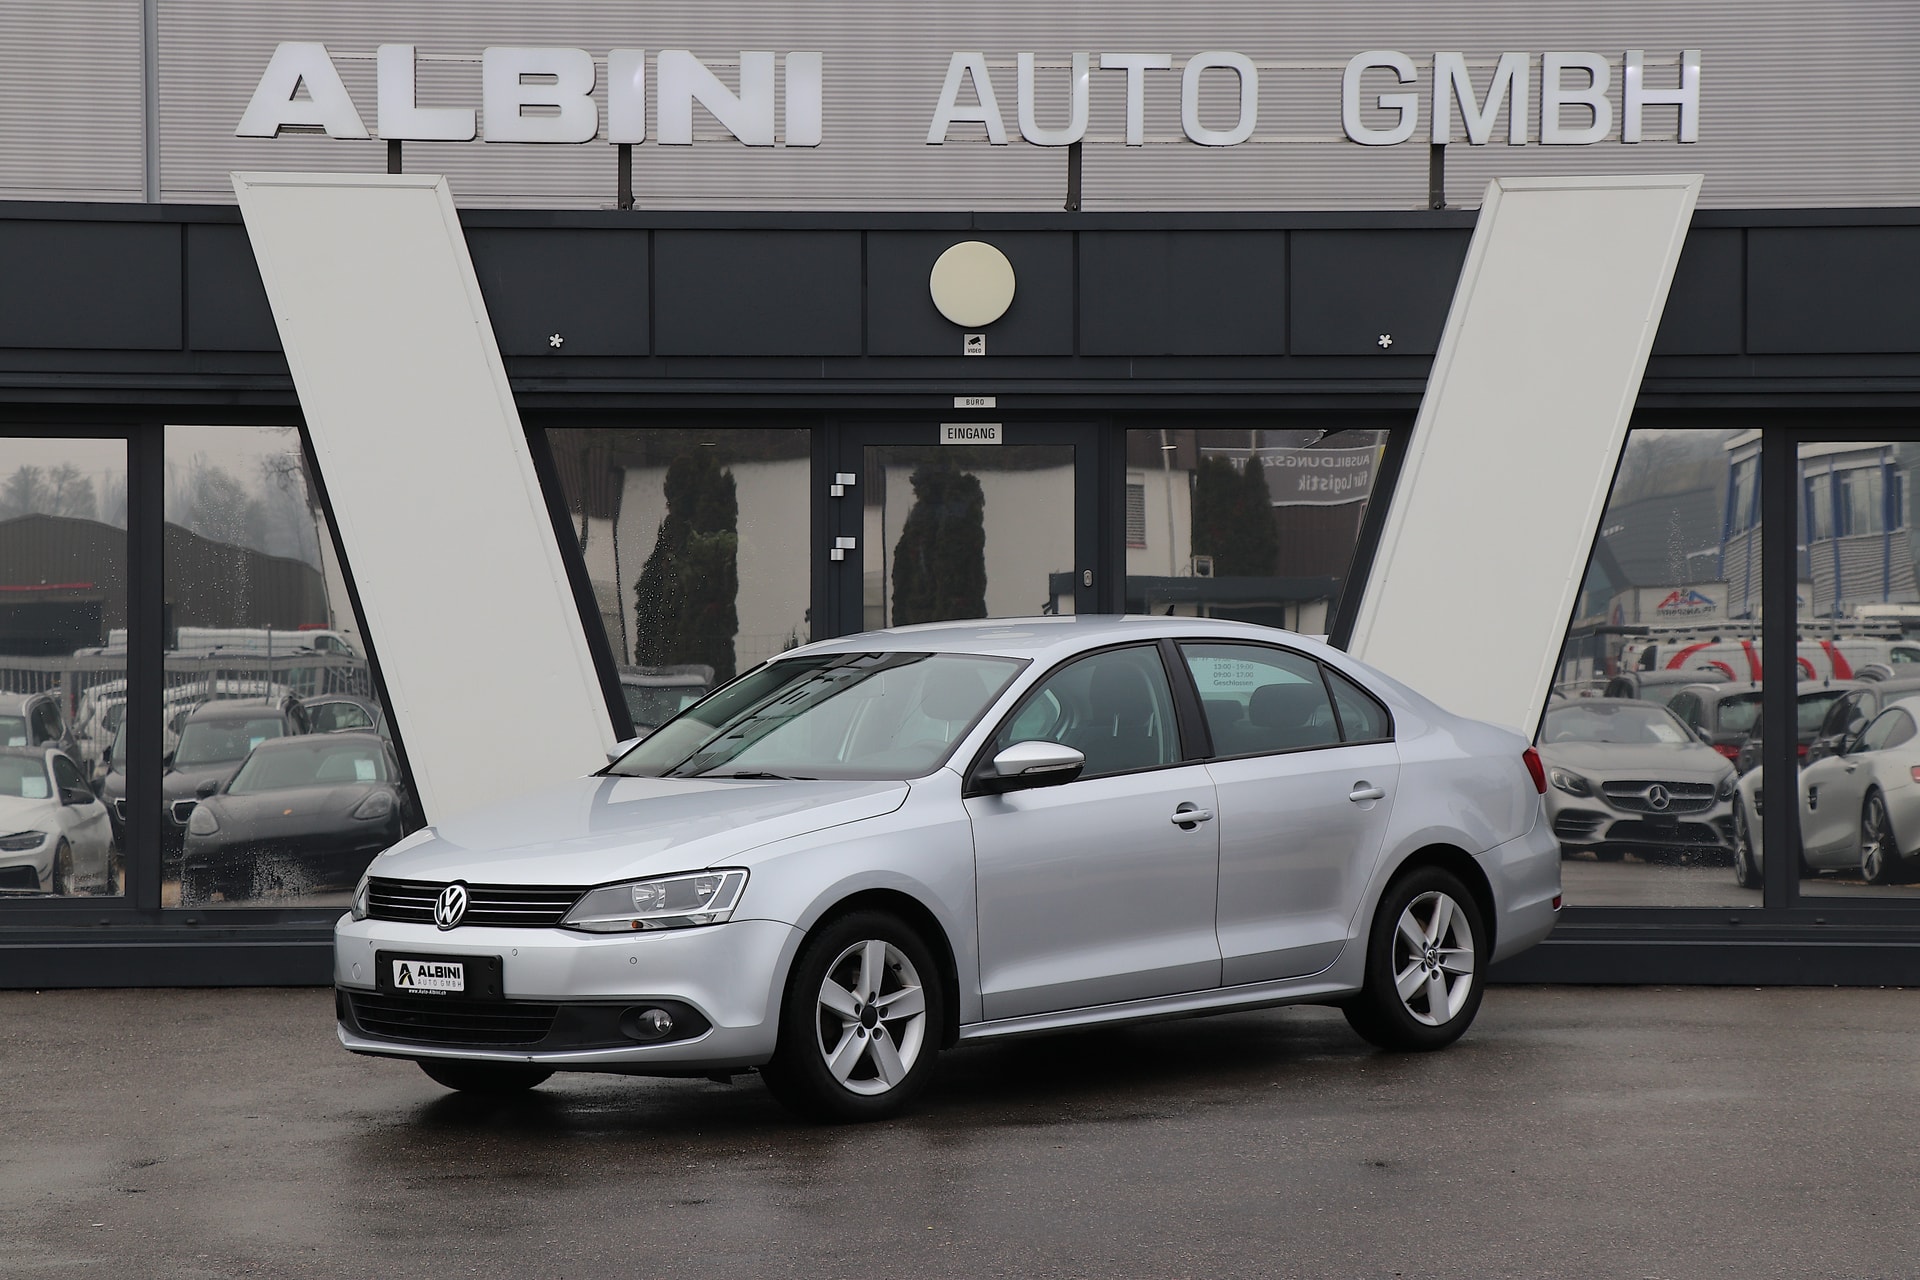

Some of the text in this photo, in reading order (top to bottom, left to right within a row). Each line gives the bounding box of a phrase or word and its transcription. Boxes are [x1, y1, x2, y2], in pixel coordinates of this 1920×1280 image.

[235, 41, 1701, 147] ALBINI AUTO GMBH
[965, 397, 985, 406] BÜRO
[947, 427, 996, 440] EINGANG
[417, 965, 461, 979] ALBINI
[417, 978, 462, 988] AUTO GMBH
